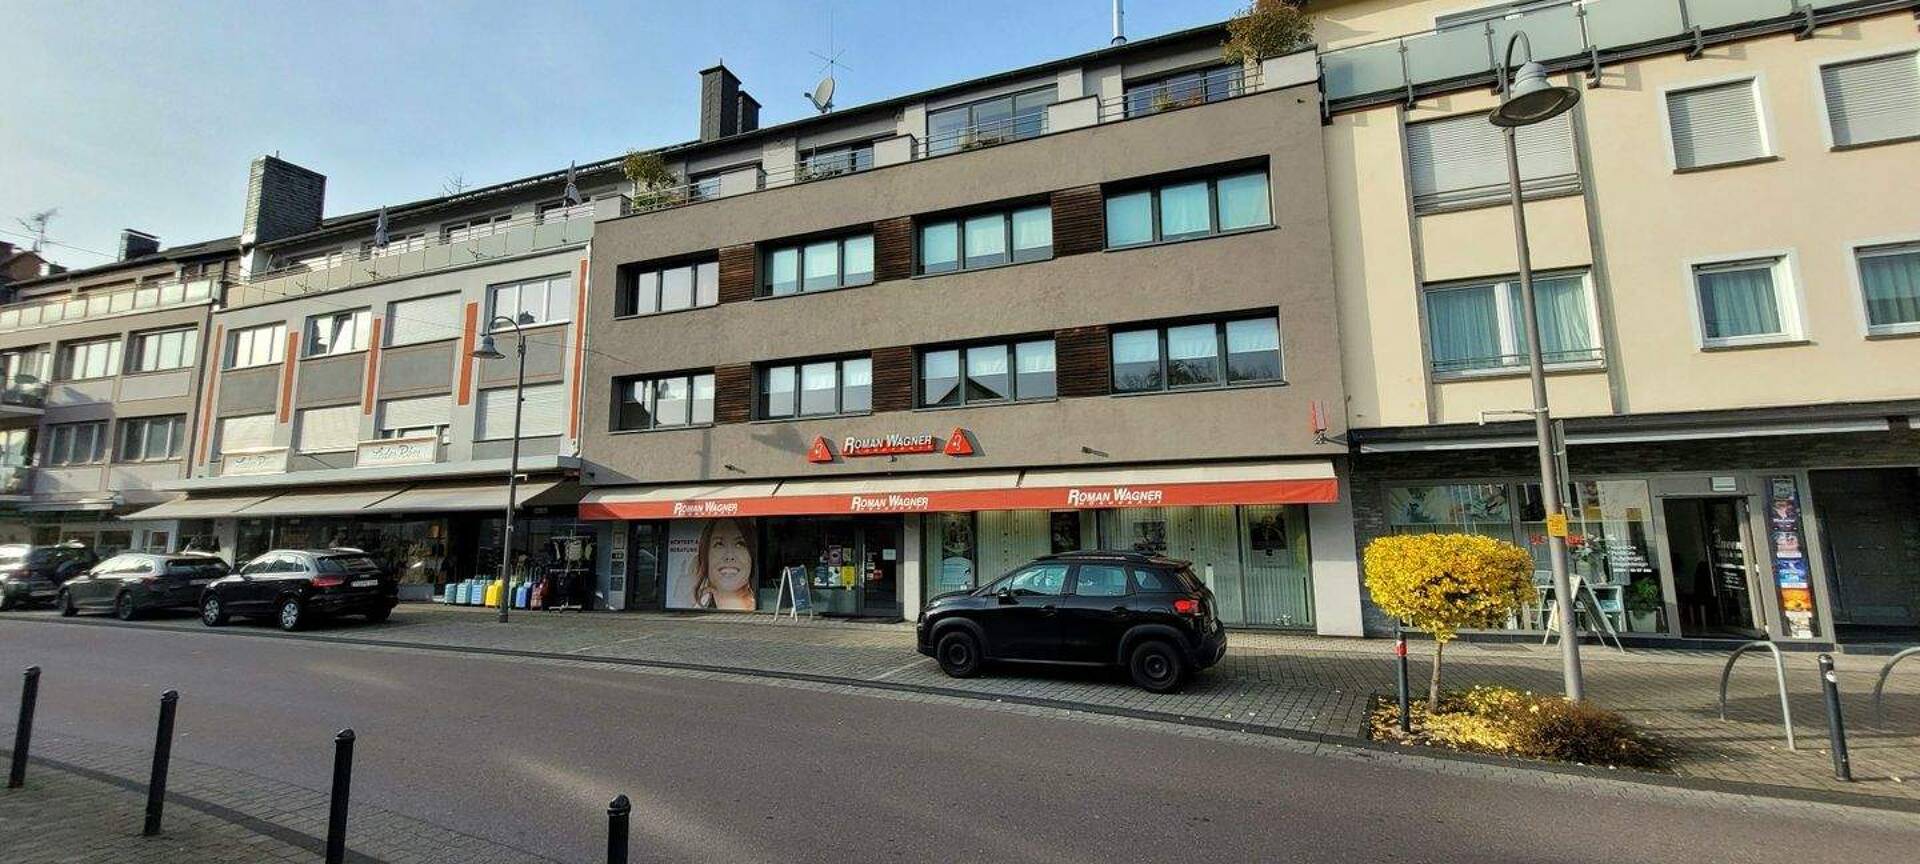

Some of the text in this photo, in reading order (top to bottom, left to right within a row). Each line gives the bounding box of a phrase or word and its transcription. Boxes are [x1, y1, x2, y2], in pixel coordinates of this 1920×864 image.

[844, 437, 884, 454] ROMAN
[886, 434, 933, 448] WAGNER
[851, 494, 928, 511] ROMAN WAGNER
[1068, 487, 1162, 506] ROMAN WAGNER
